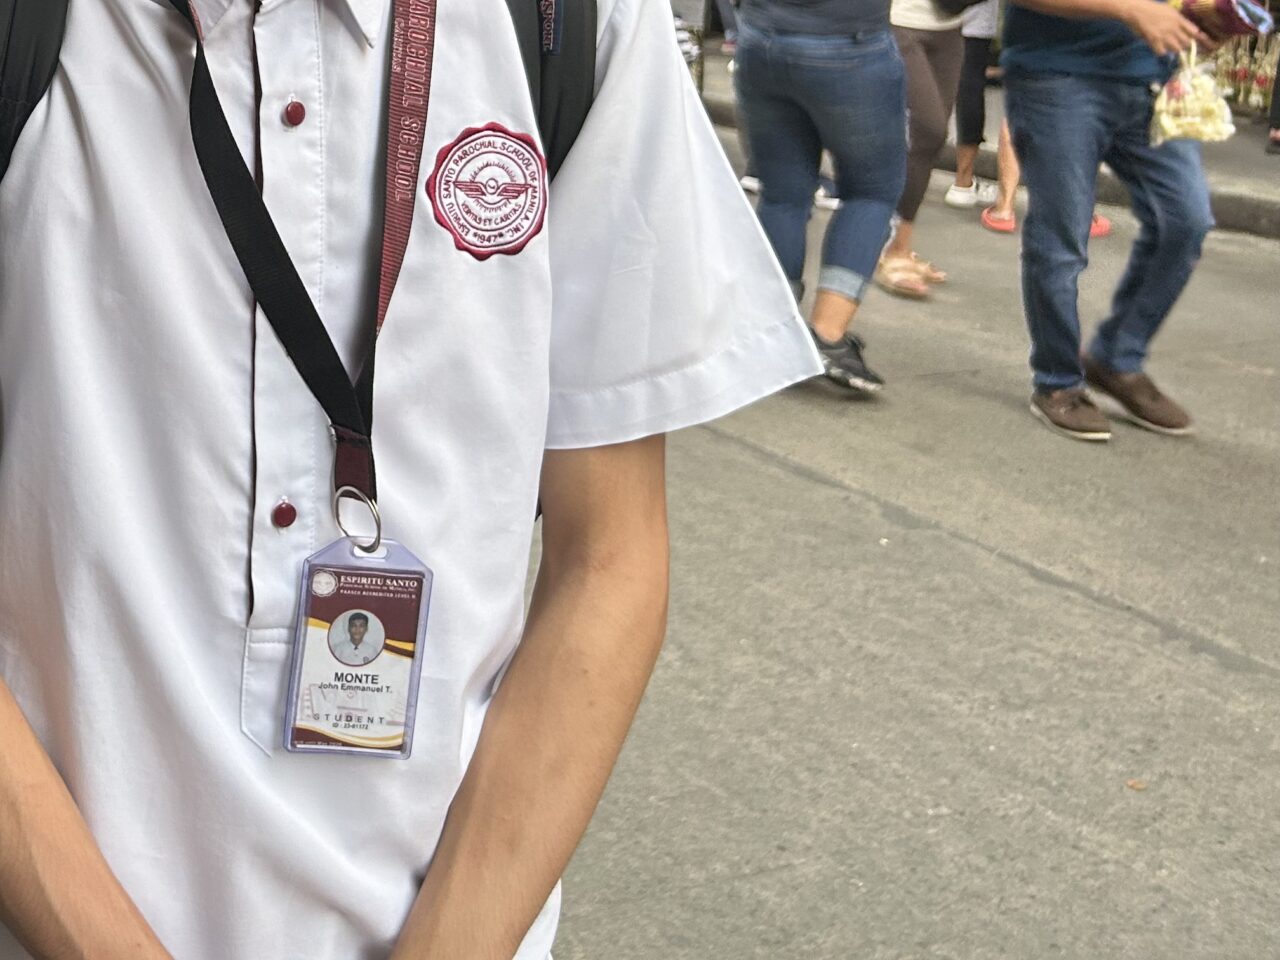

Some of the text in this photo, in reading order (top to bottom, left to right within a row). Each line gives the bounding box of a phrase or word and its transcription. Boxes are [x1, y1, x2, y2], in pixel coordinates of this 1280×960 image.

[395, 116, 420, 202] SCHOOL
[443, 167, 456, 199] SANTO
[454, 140, 498, 167] PAROCHIAL
[500, 141, 532, 171] SCHOOL
[528, 171, 537, 183] OF
[483, 217, 493, 226] ET
[494, 203, 521, 226] CARITAS
[340, 575, 384, 585] ESPIRITU
[386, 579, 418, 588] SANTO
[334, 672, 379, 684] MONTE
[318, 682, 338, 690] John
[341, 683, 383, 693] Emmanuel
[313, 713, 385, 724] STUDENT
